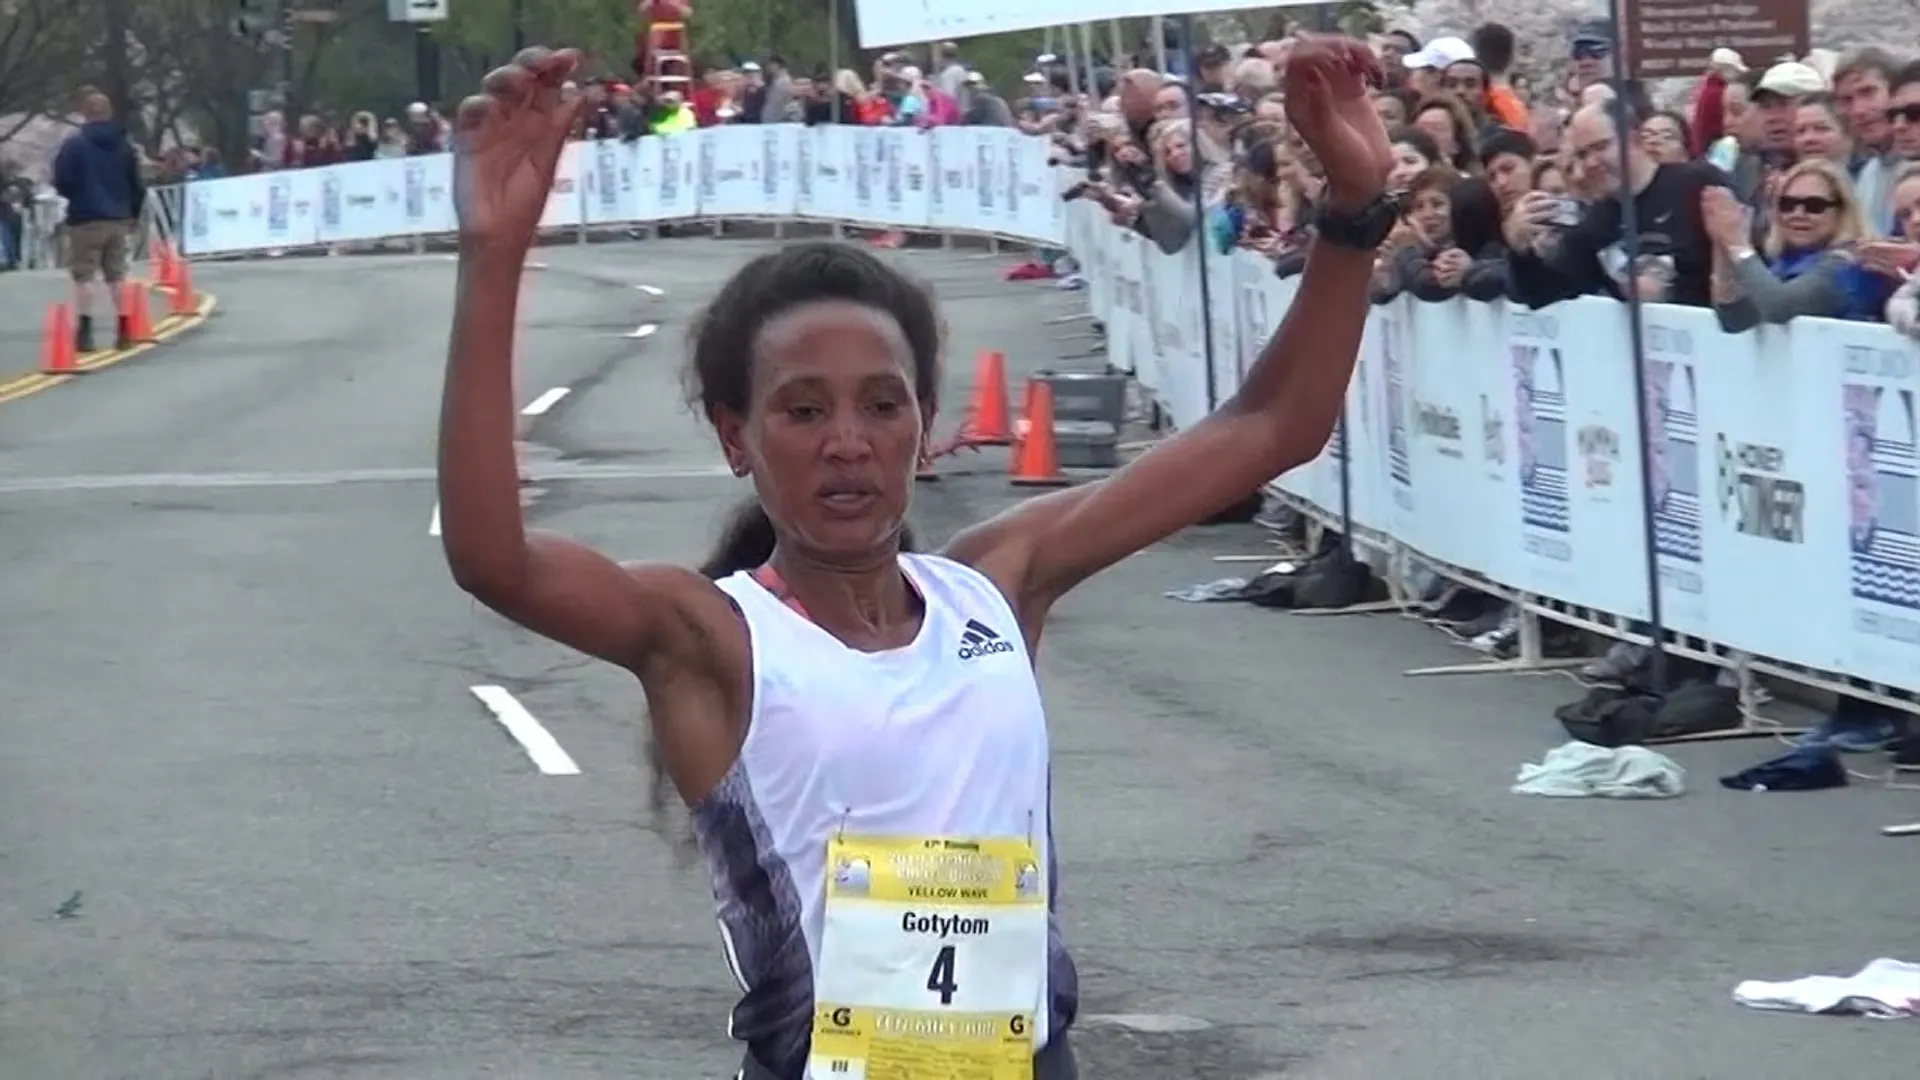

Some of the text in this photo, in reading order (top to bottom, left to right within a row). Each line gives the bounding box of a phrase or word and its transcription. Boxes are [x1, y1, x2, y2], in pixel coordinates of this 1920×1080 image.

[958, 640, 1014, 660] adidas
[908, 887, 988, 898] YELLOW WAVE
[902, 911, 989, 937] Gotytom
[926, 945, 958, 1005] 4
